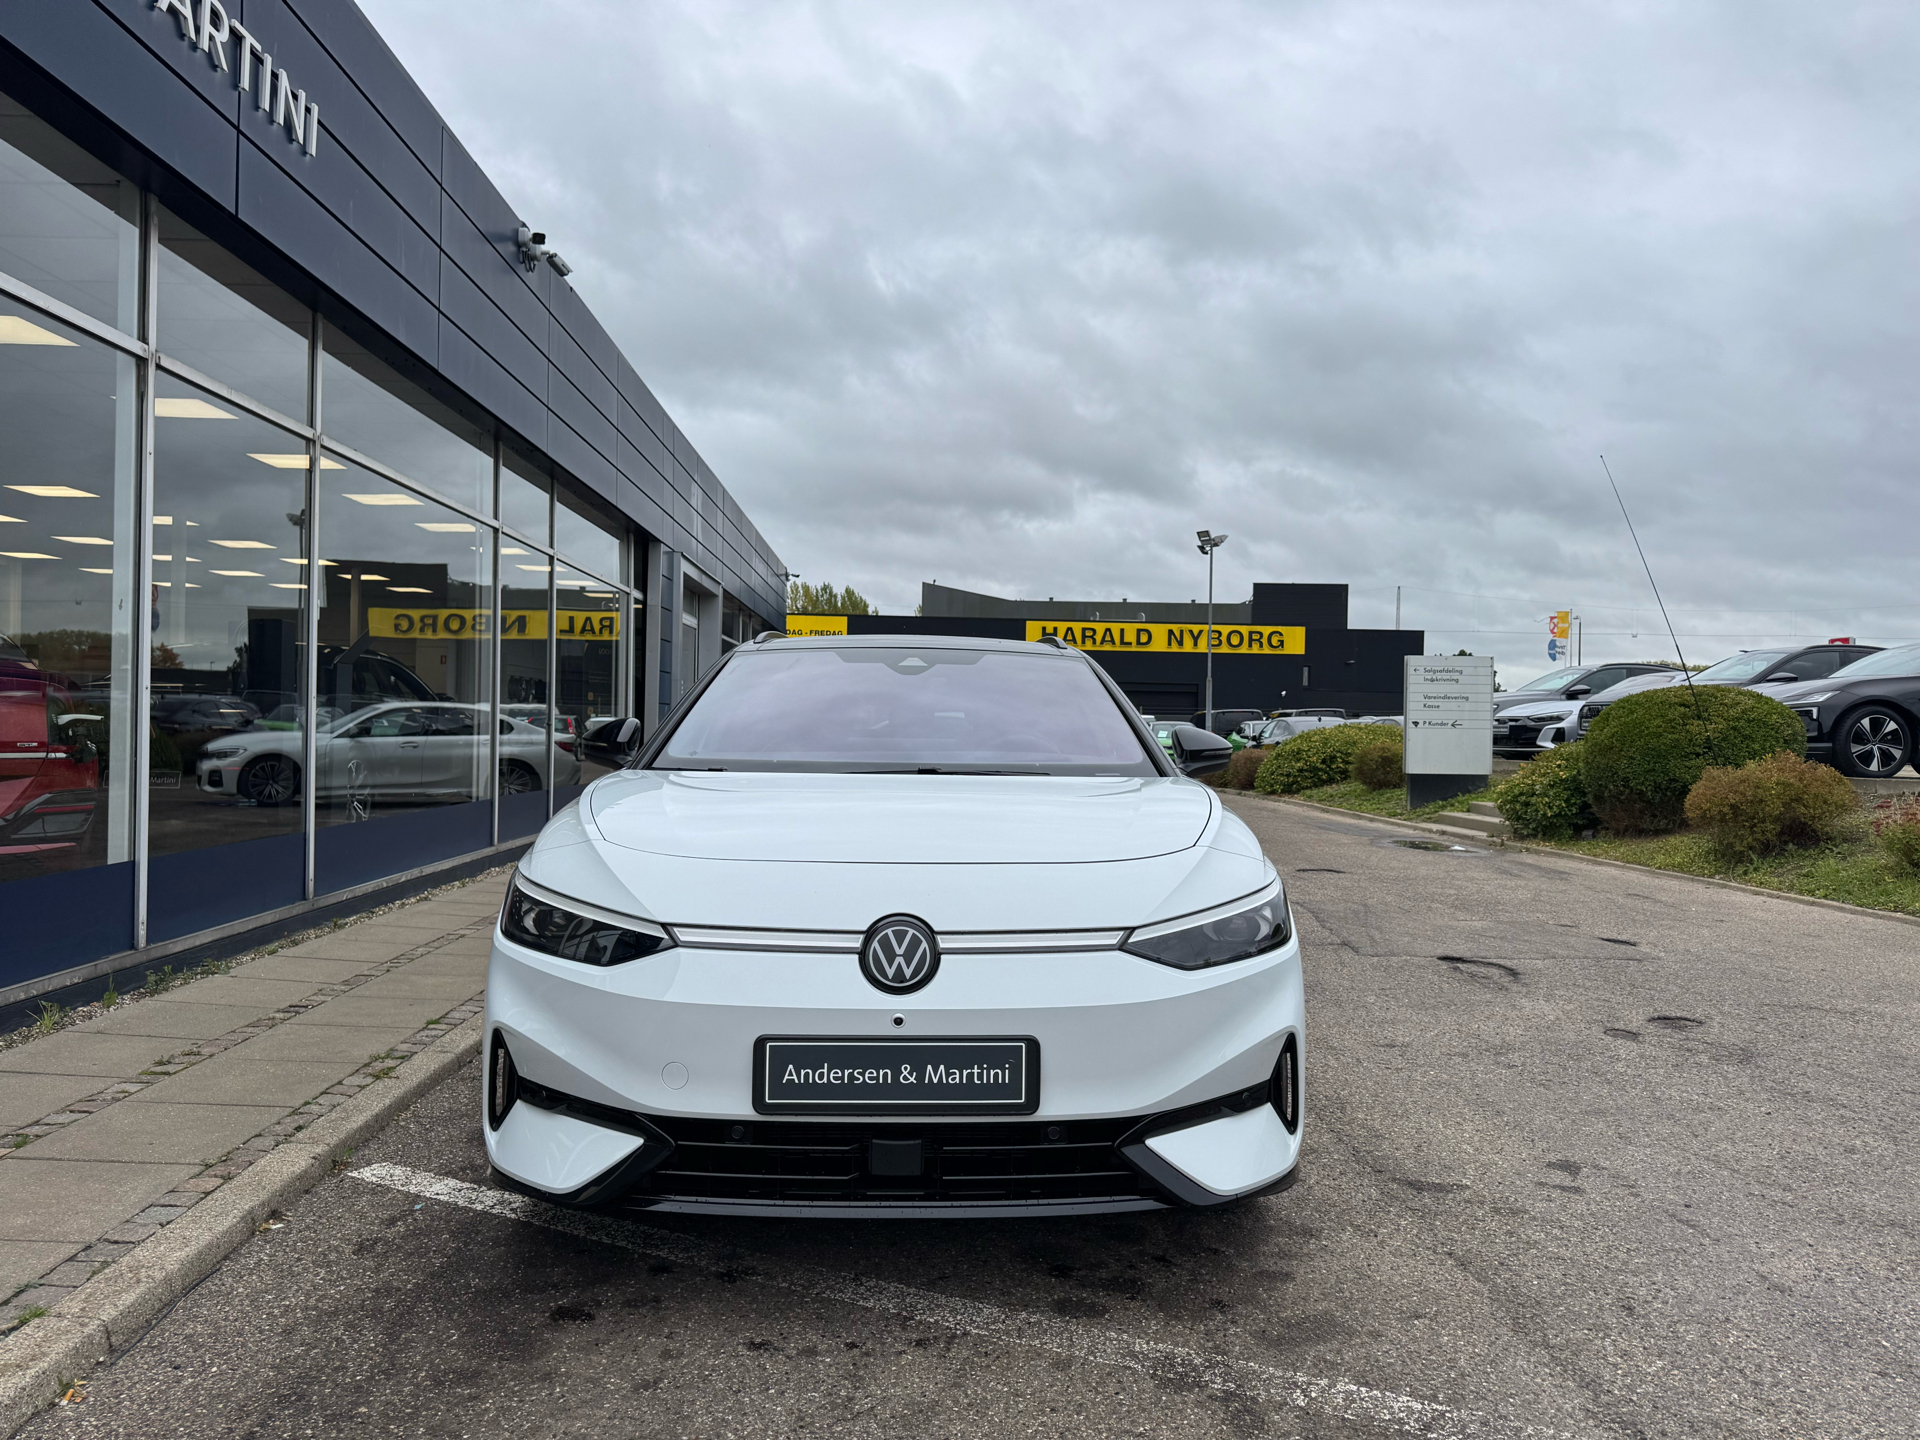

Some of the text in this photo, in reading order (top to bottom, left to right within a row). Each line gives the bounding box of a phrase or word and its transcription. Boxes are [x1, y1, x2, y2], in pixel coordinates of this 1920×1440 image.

[1041, 626, 1285, 649] HARALD NYBORG
[1423, 667, 1463, 675] Salgsafdeling
[1423, 694, 1469, 702] Vareindlevering
[150, 776, 176, 784] Martini
[782, 1063, 1010, 1084] Andersen & Martini
